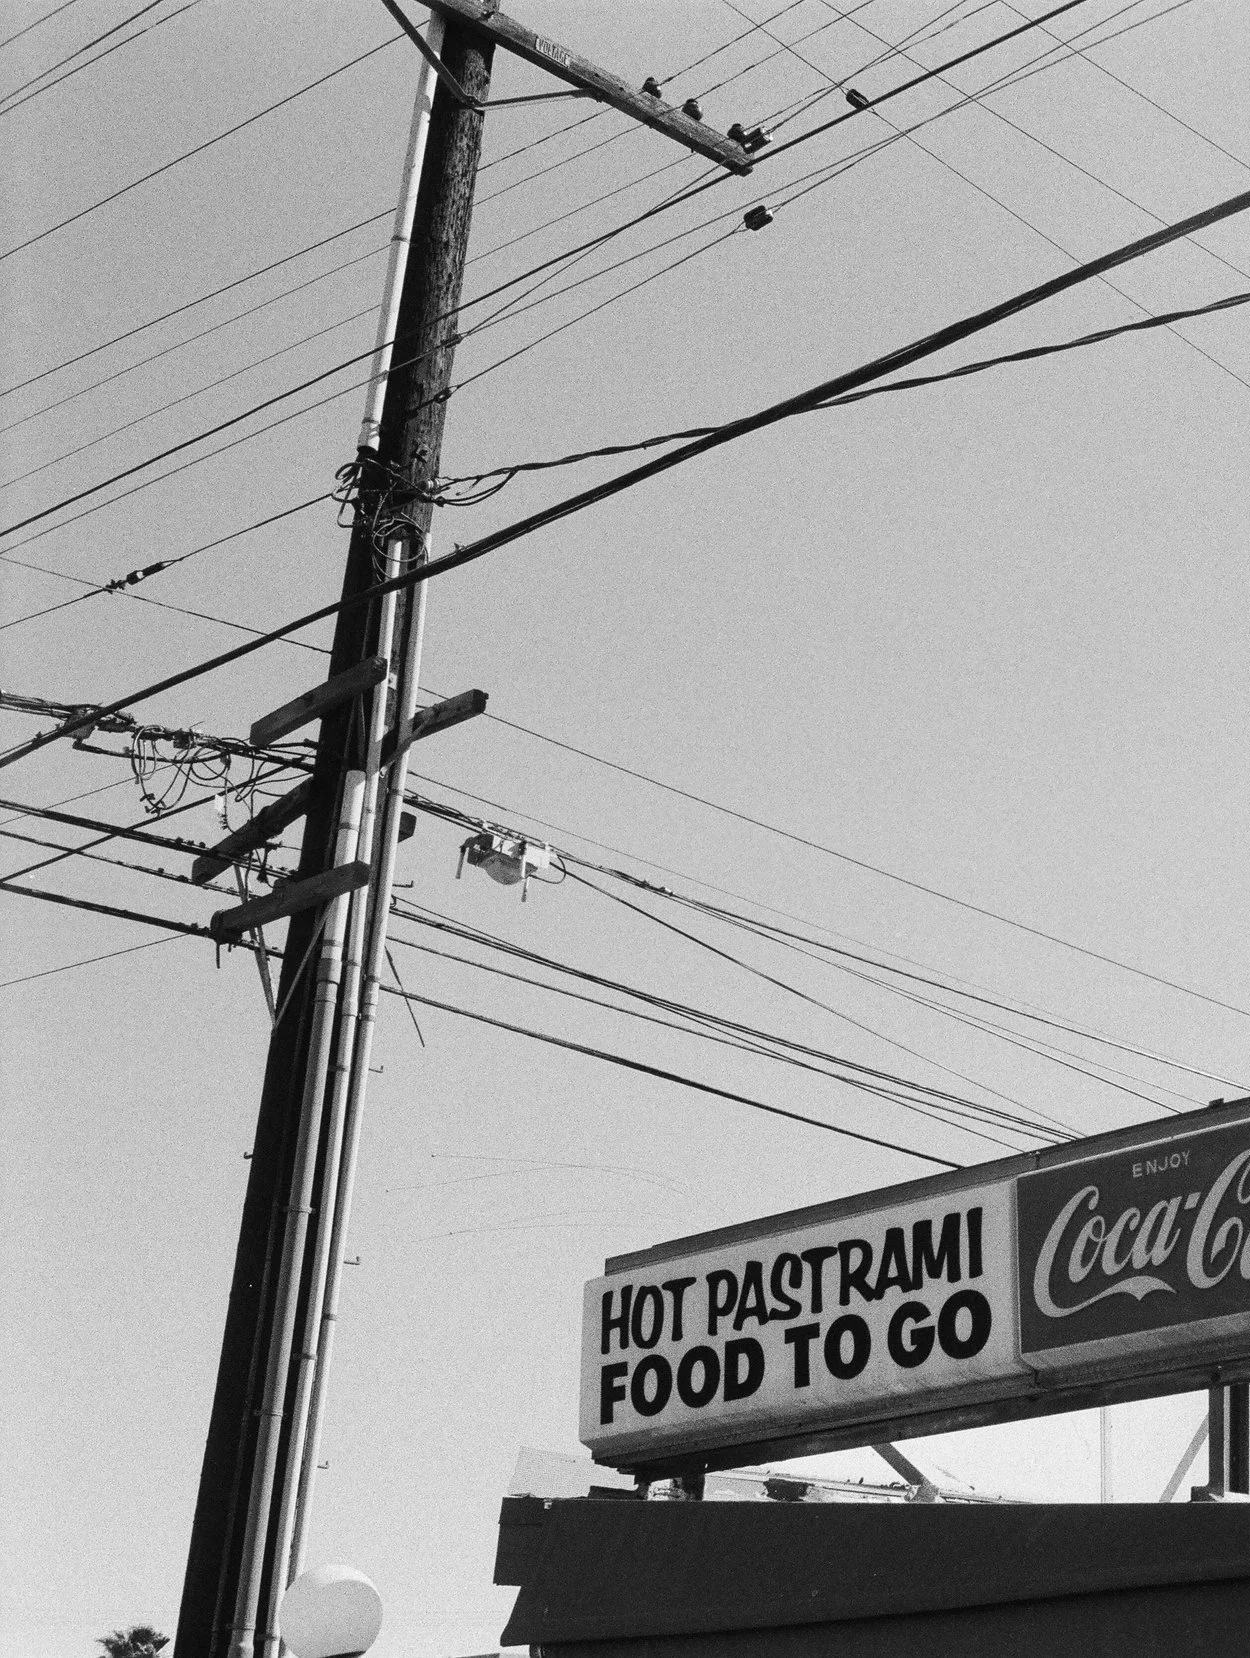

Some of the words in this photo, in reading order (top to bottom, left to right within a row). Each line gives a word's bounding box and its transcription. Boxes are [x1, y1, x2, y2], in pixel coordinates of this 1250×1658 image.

[1132, 1149, 1192, 1178] ENJOY
[602, 1276, 697, 1355] HOT
[707, 1207, 983, 1337] PASTRAMI
[600, 1338, 765, 1426] FOOD
[784, 1310, 871, 1389] TO
[887, 1289, 993, 1369] GO
